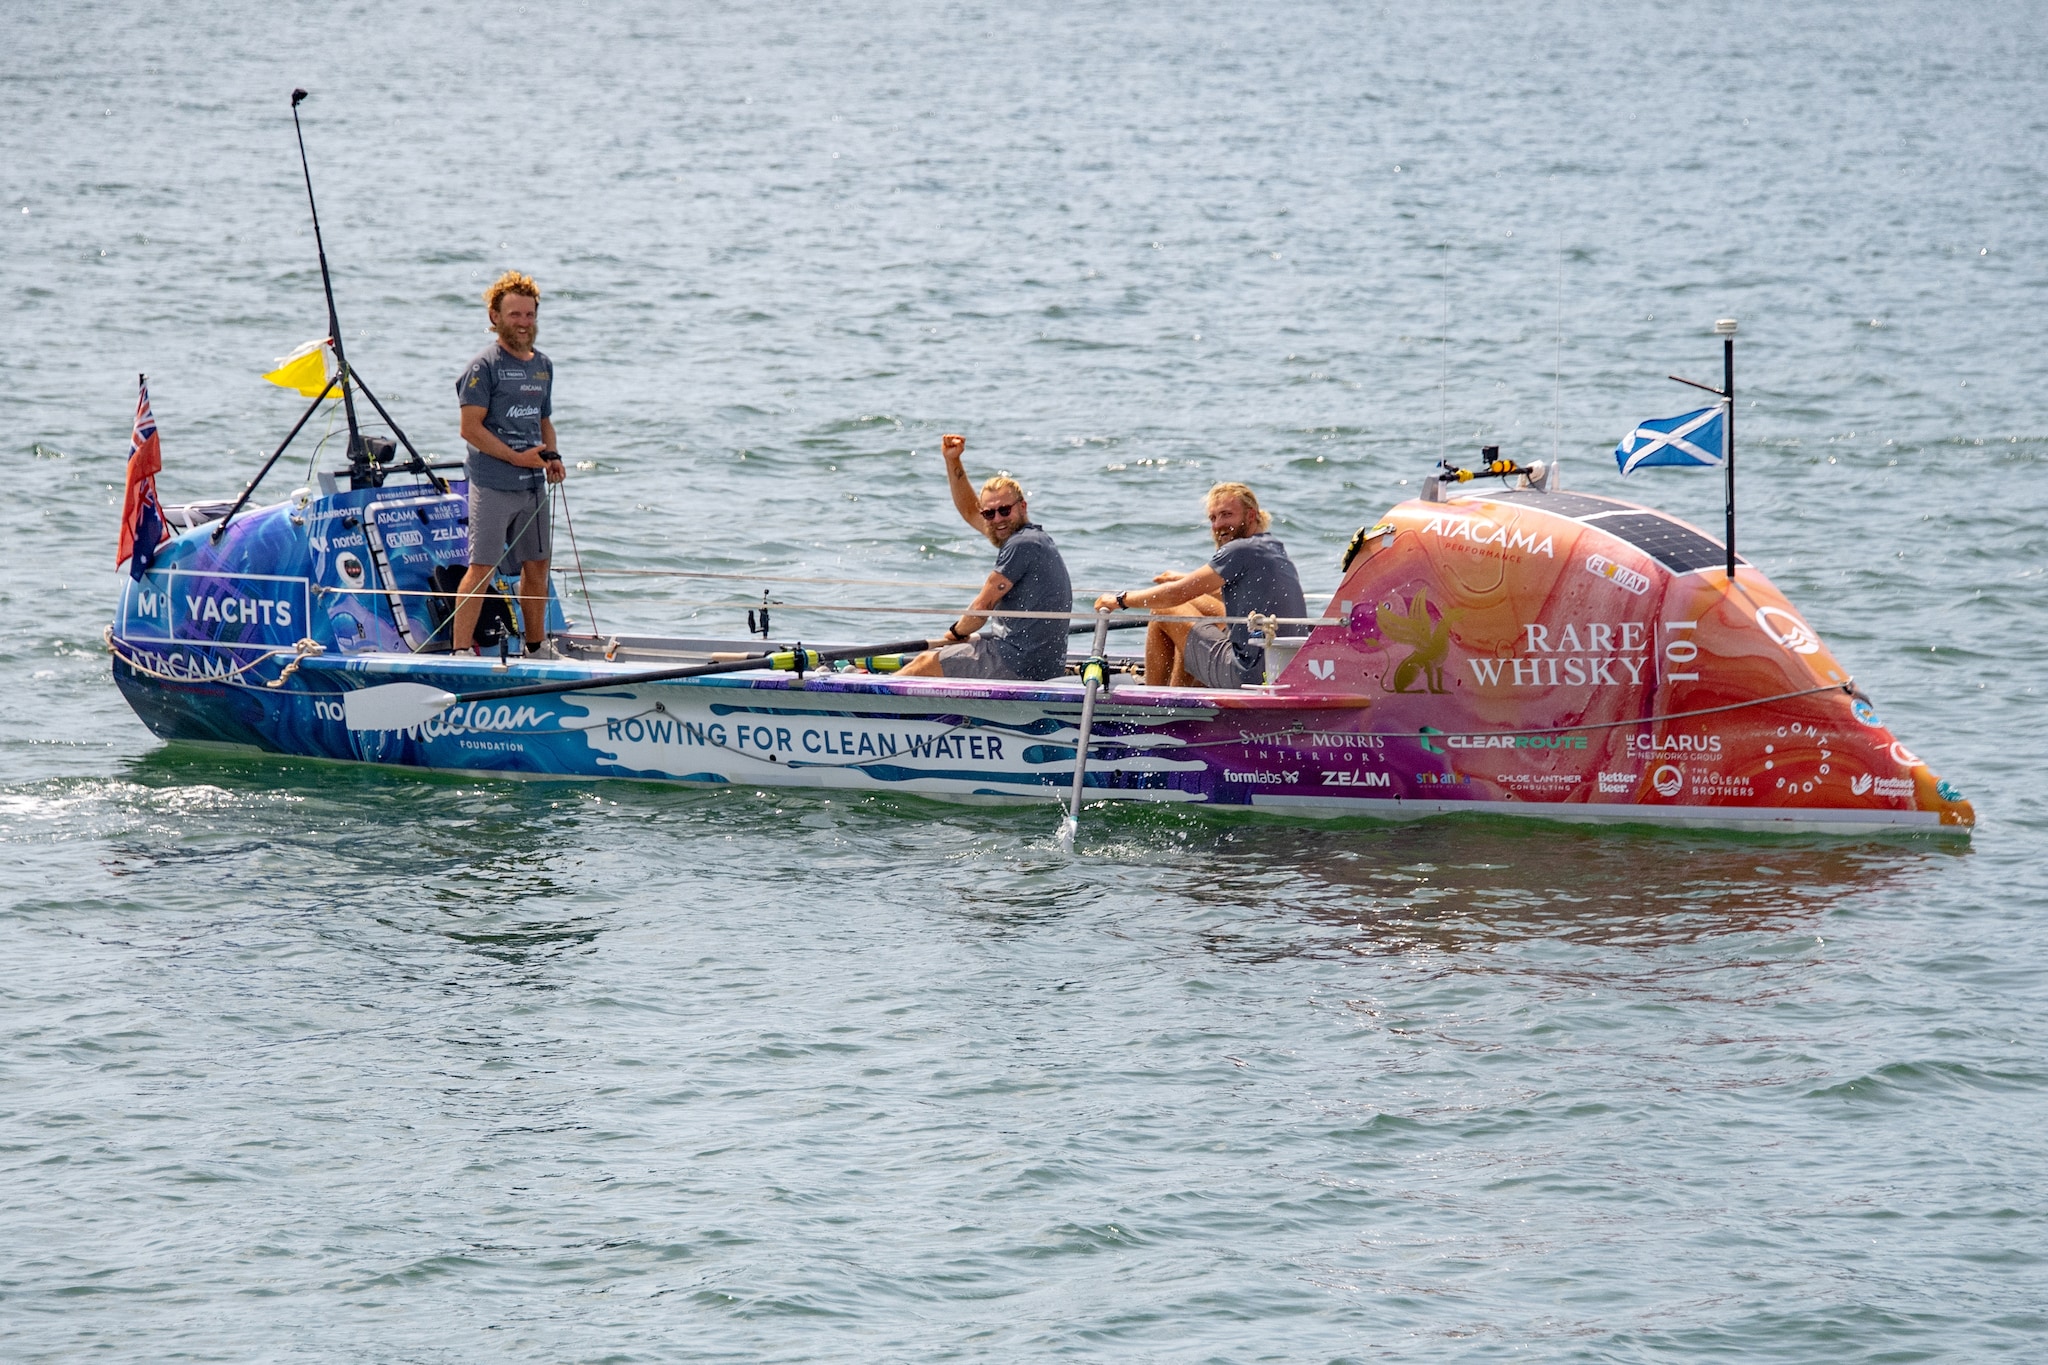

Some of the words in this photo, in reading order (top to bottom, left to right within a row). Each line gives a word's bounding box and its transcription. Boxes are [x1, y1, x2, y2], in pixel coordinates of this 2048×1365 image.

[377, 510, 419, 526] ATACAMA
[332, 532, 364, 549] norda
[1421, 517, 1554, 559] ATACAMA
[1445, 541, 1522, 564] PERFORMANCE
[186, 595, 292, 627] YACHTS
[1523, 622, 1648, 654] RARE
[1667, 620, 1700, 684] 101
[130, 650, 247, 686] ATACAMA
[1467, 656, 1649, 687] WHISKY
[460, 740, 524, 752] FOUNDATION
[606, 716, 728, 746] ROWING
[737, 725, 792, 752] FOR
[802, 728, 897, 757] CLEAN
[905, 734, 1005, 760] WATER
[1239, 729, 1294, 746] SWIFT
[1311, 732, 1385, 748] MORRIS
[1447, 736, 1588, 749] CLEARROUTE
[1626, 734, 1636, 759] THE
[1636, 734, 1722, 752] CLARUS
[1244, 750, 1385, 762] INTERIORS
[1636, 751, 1688, 761] NETWORKS
[1690, 752, 1723, 762] GROUP
[1223, 769, 1282, 784] formlabs
[1321, 768, 1391, 787] ZELIM
[1497, 774, 1530, 783] CHLOE
[1533, 774, 1582, 783] LANTHIER
[1597, 771, 1638, 783] Better
[1692, 775, 1750, 786] MACLEAN
[1598, 783, 1630, 794] Beer.
[1692, 786, 1755, 797] BROTHERS
